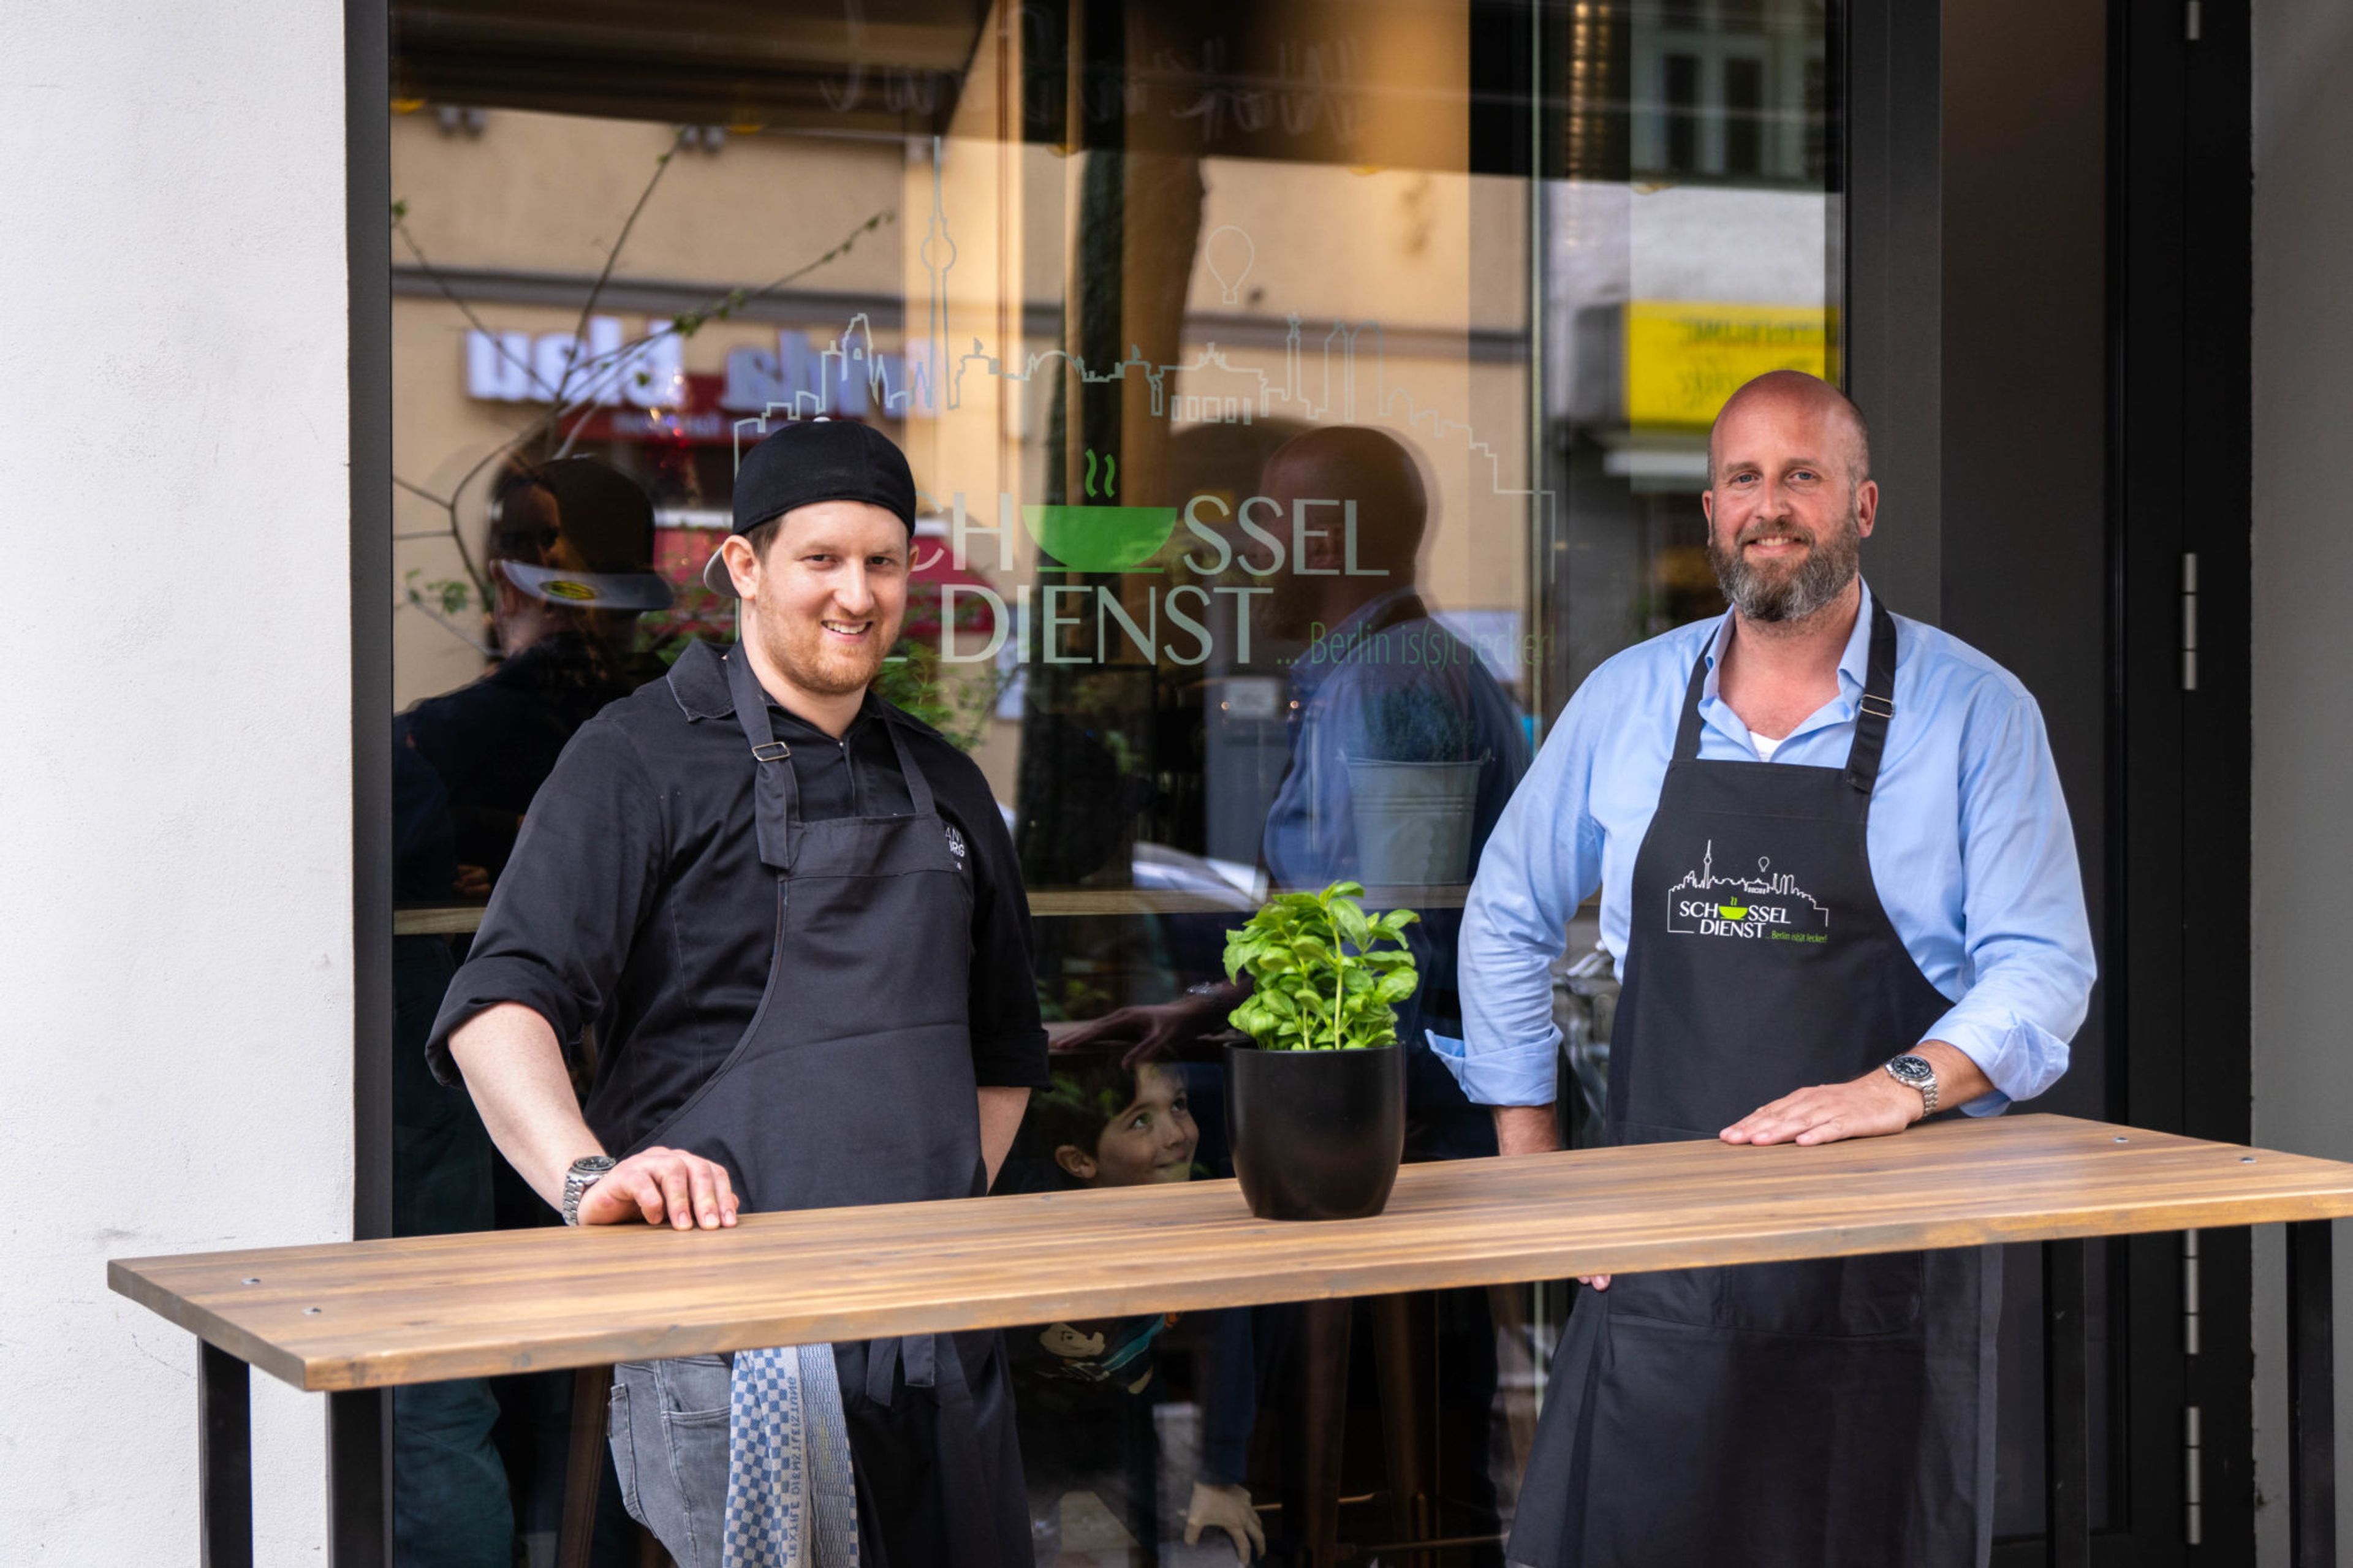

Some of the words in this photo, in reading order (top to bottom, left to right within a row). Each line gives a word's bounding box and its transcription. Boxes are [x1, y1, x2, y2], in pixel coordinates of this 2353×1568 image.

[941, 583, 1274, 666] DIENST
[1310, 621, 1391, 665] Berlin
[1401, 622, 1460, 672] is(s)t
[1700, 919, 1767, 939] DIENST
